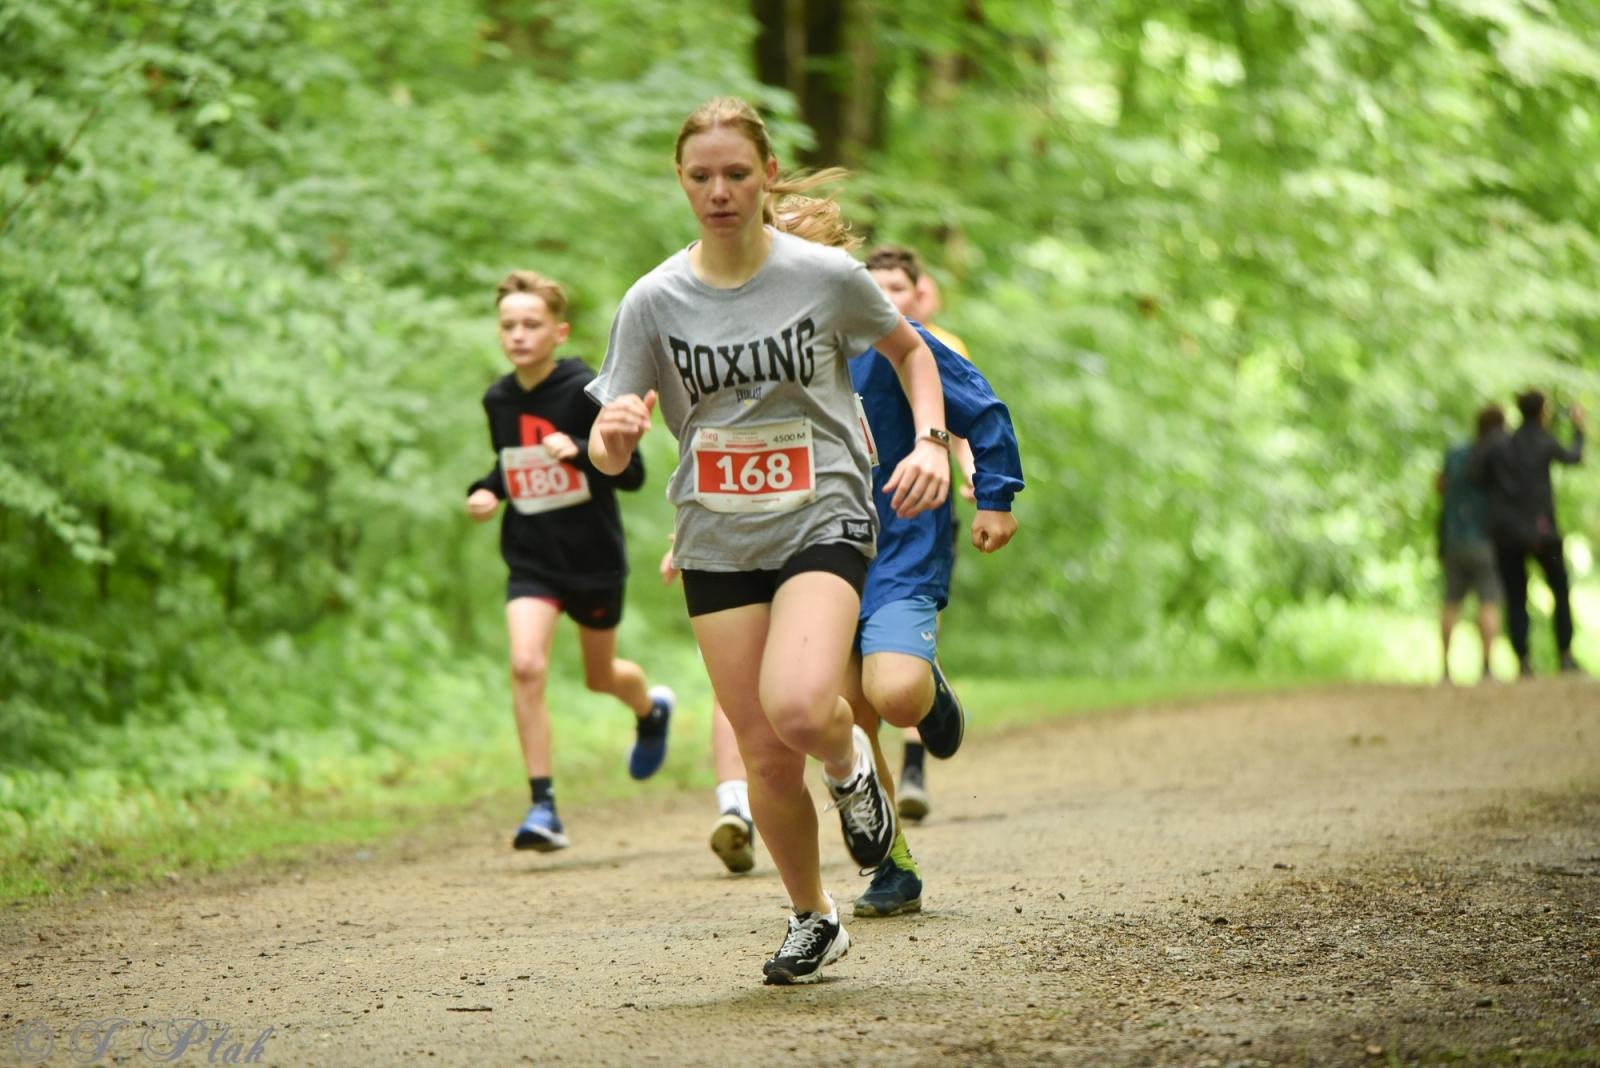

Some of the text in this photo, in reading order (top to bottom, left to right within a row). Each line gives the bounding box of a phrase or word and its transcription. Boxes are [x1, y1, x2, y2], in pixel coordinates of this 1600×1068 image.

[668, 317, 816, 407] BOXING
[772, 434, 795, 443] 4500
[796, 431, 807, 440] M
[515, 464, 570, 498] 180
[716, 452, 793, 493] 168
